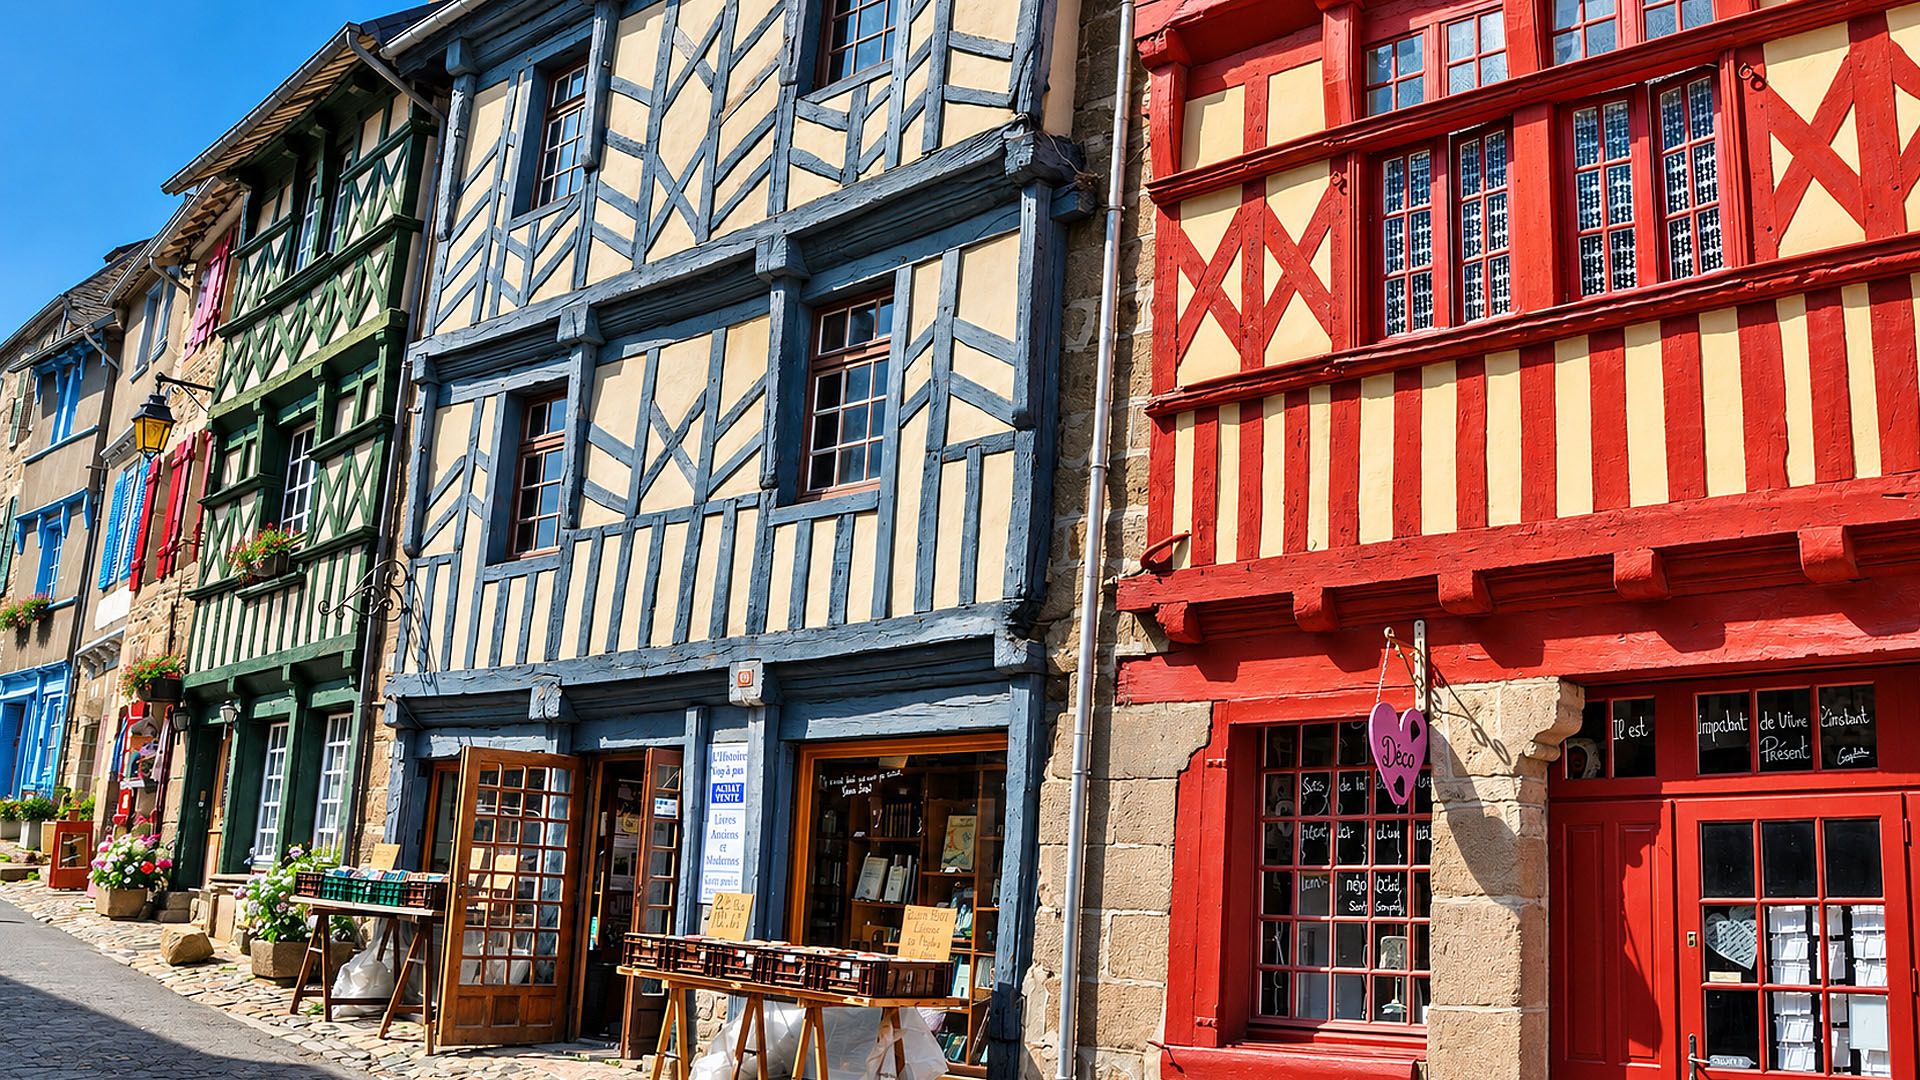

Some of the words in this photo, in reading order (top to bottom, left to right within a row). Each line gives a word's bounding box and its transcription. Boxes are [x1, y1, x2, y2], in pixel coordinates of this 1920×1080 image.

[1628, 716, 1649, 738] est
[1760, 711, 1775, 730] de
[1382, 735, 1415, 768] Déco
[1760, 736, 1811, 763] Présent
[715, 793, 740, 802] VENTE
[714, 813, 737, 825] Livres
